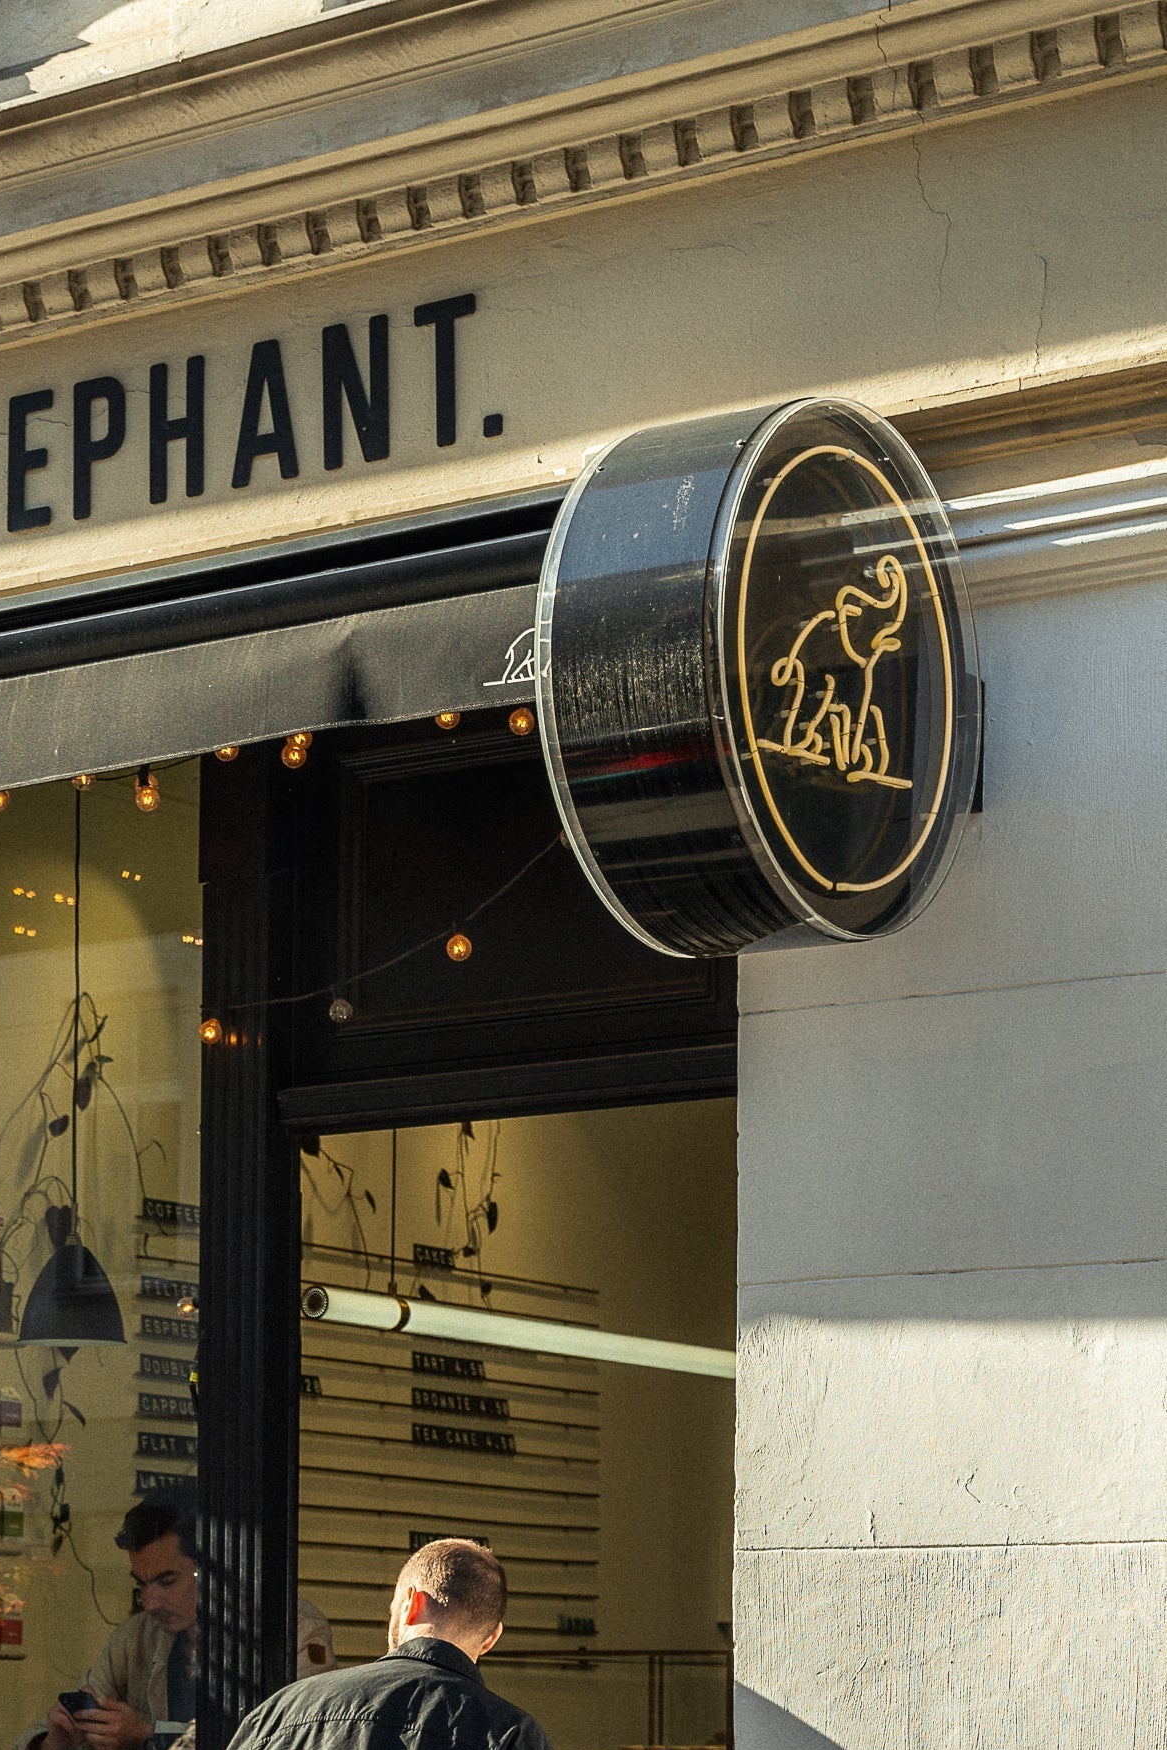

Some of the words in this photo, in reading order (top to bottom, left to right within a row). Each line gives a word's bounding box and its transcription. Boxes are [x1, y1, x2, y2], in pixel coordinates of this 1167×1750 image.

[415, 1354, 445, 1371] TART
[414, 1390, 471, 1411] BROWNIE
[414, 1426, 438, 1441] TEA
[140, 1435, 175, 1451] FLAT
